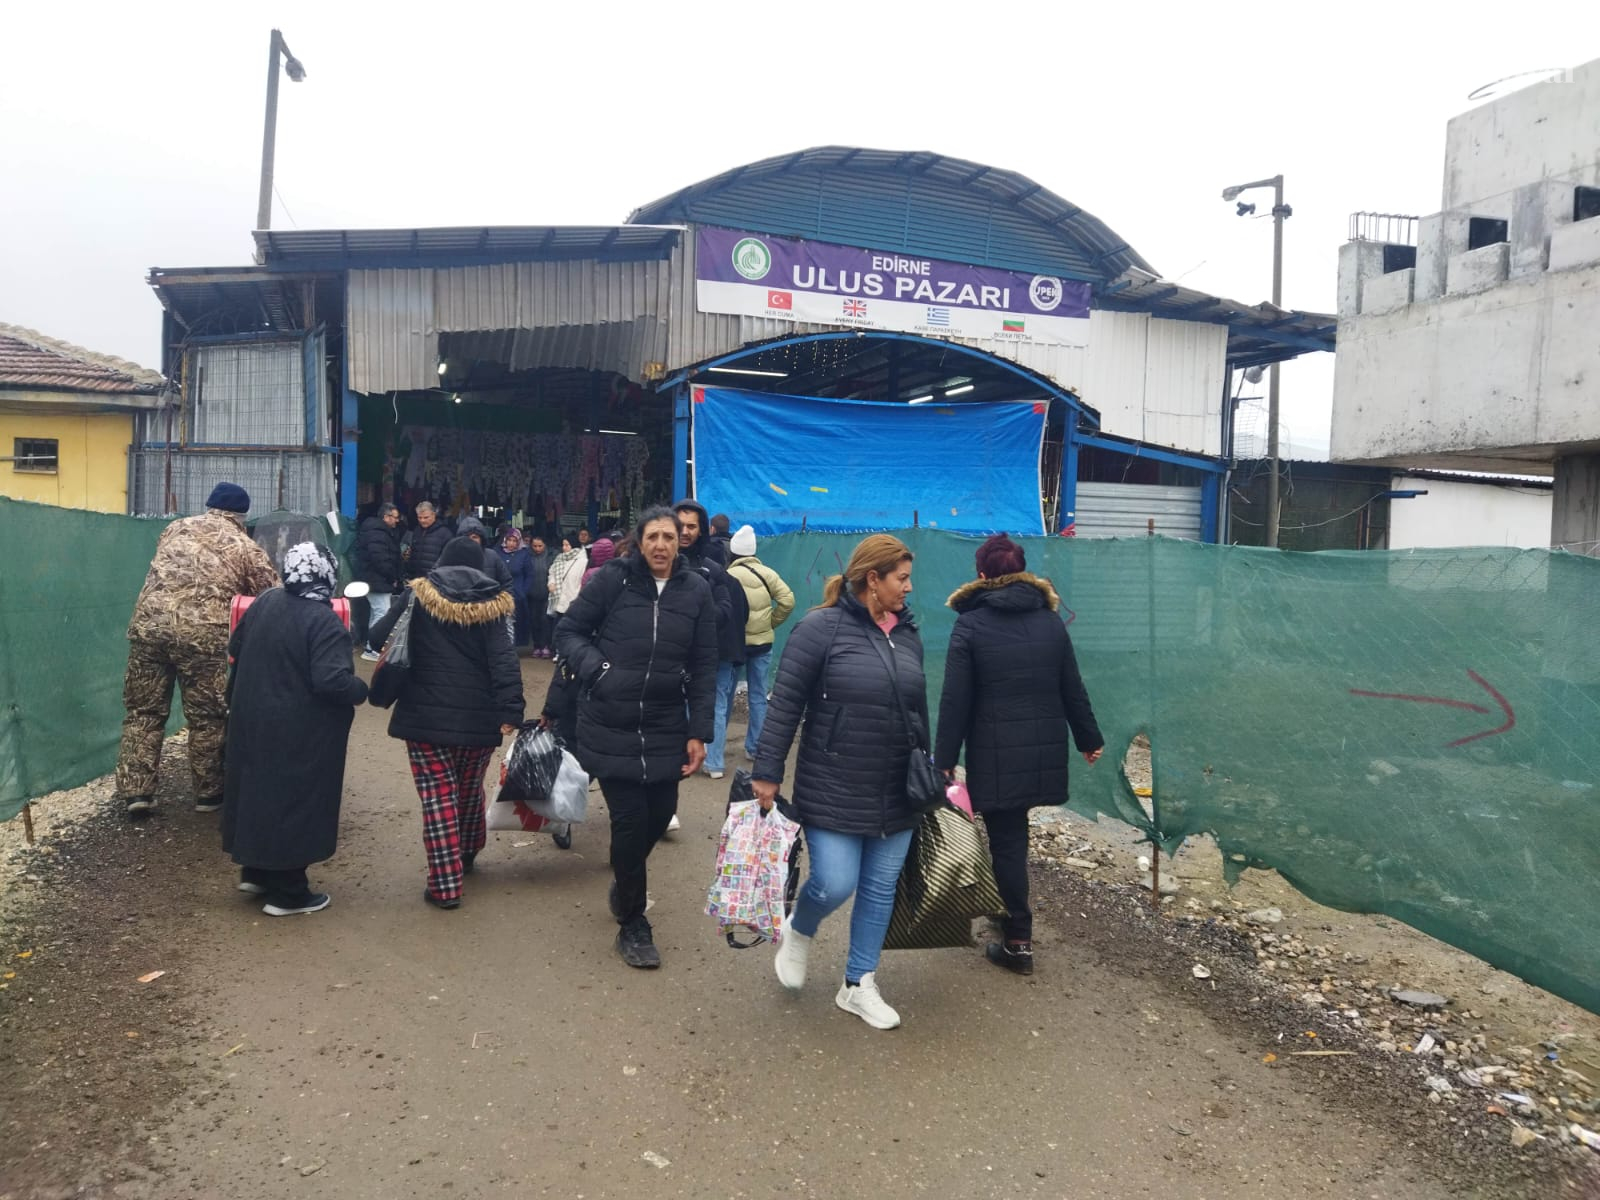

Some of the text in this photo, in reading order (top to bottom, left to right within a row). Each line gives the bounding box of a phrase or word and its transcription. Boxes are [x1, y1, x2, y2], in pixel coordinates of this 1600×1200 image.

[872, 255, 931, 275] EDİRNE
[793, 264, 883, 296] ULUS
[895, 277, 1010, 308] PAZARI
